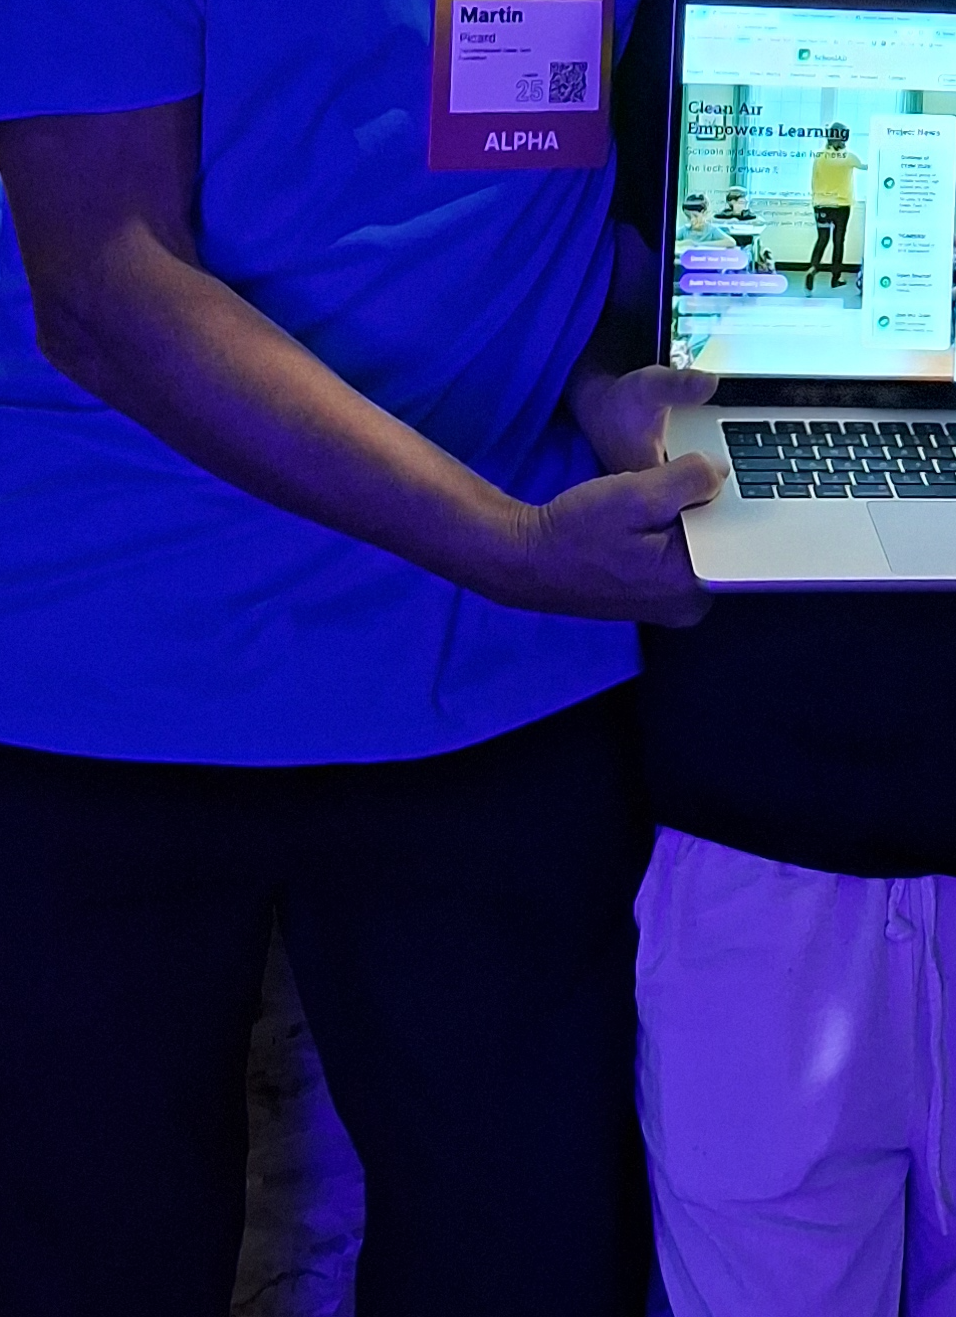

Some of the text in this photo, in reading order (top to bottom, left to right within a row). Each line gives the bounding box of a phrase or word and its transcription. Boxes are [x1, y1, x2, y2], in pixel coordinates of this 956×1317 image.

[460, 6, 523, 24] Martin
[459, 32, 496, 44] Picard
[515, 79, 544, 103] 25
[688, 100, 763, 116] Clean Air
[484, 131, 559, 152] ALPHA
[687, 122, 851, 142] Empowers Learning
